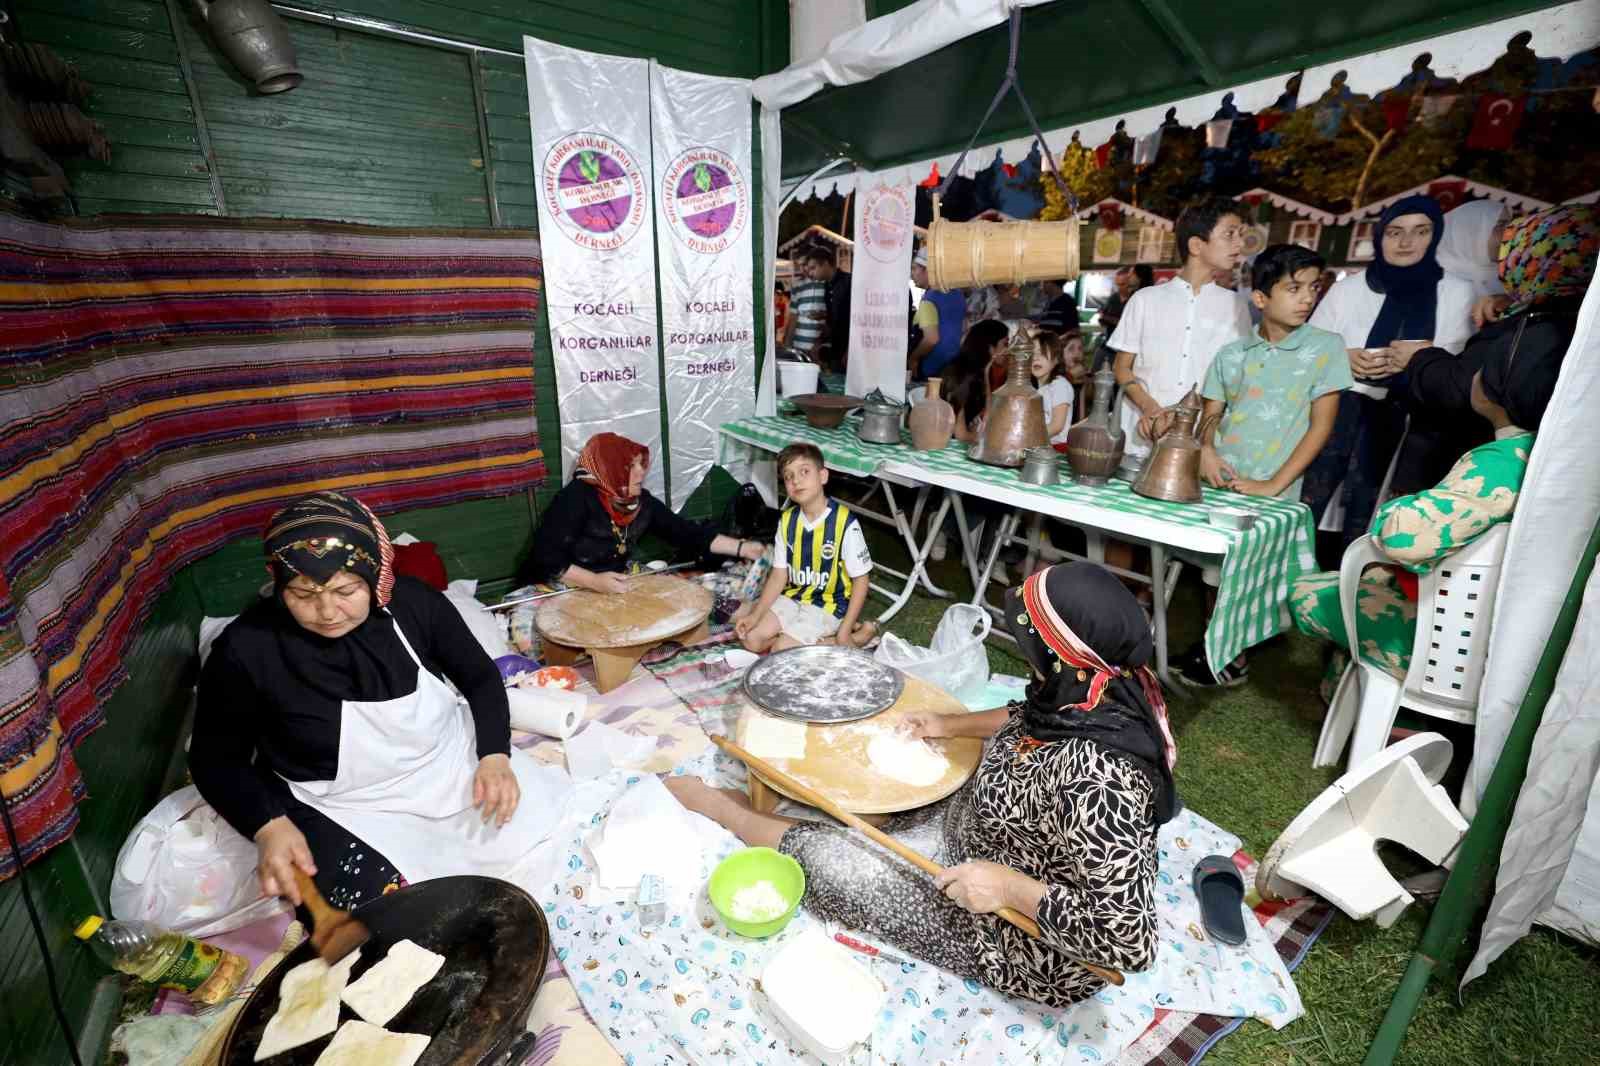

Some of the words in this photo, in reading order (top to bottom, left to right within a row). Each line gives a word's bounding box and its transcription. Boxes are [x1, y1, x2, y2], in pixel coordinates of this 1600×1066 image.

[574, 301, 634, 316] KOCAELİ
[686, 301, 735, 313] KOCAELİ
[559, 335, 652, 350] KORGANLILAR
[670, 330, 749, 345] KORGANLILAR
[580, 366, 637, 383] DERNEĞİ
[687, 359, 736, 375] DERNEĞİ
